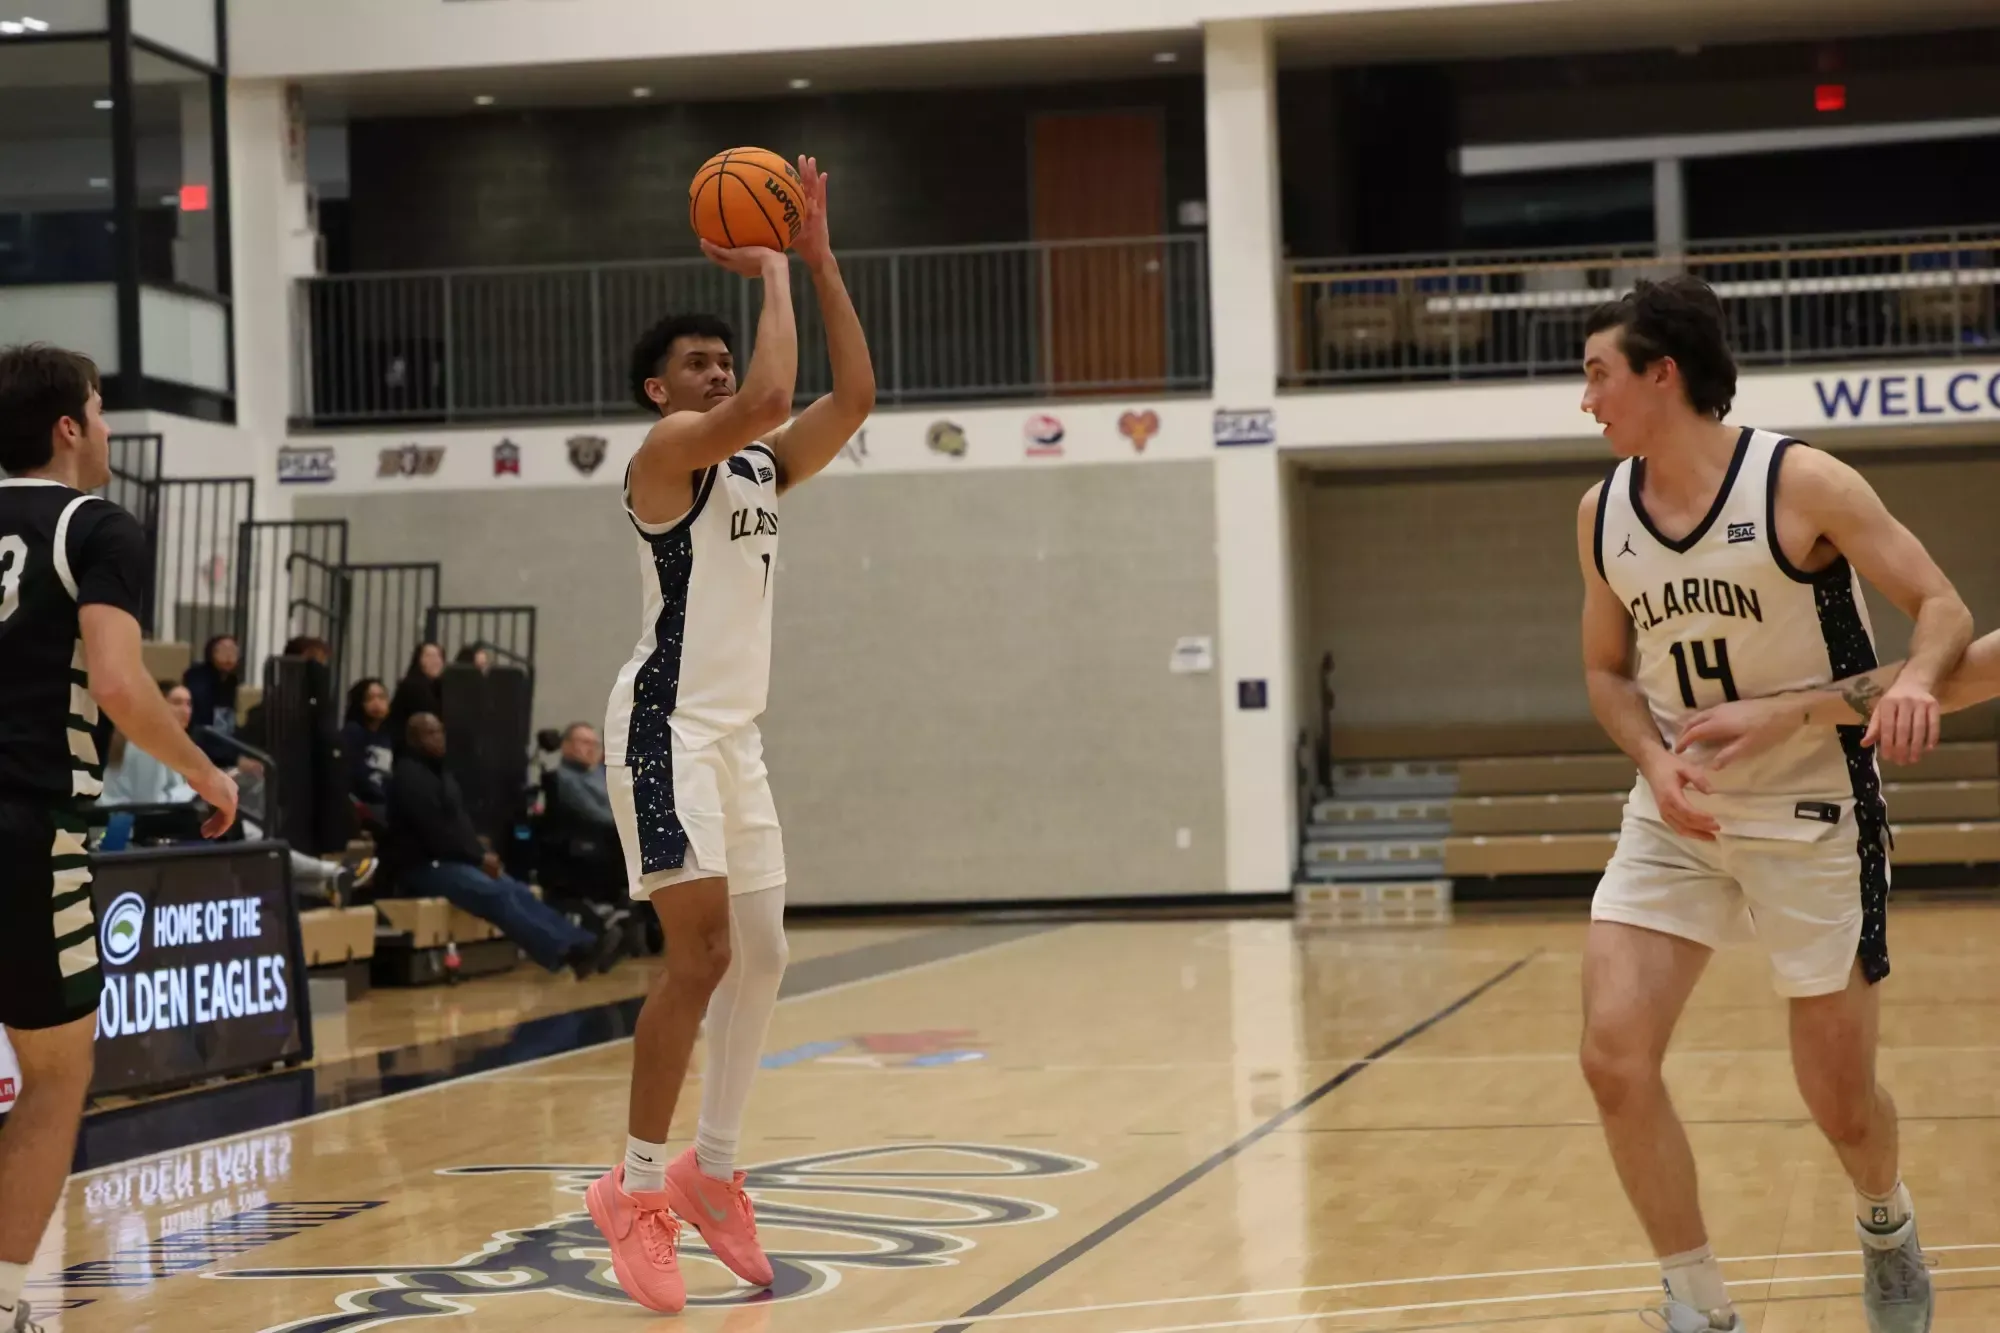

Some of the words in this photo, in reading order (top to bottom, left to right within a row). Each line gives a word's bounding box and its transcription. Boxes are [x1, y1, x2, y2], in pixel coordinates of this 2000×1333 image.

[1728, 526, 1756, 539] PSAC
[1631, 578, 1763, 631] CLARION
[1669, 638, 1741, 708] 14
[153, 902, 203, 948] HOME
[204, 900, 228, 942] OF
[229, 897, 262, 938] THE
[93, 966, 189, 1041] OLDEN
[194, 954, 288, 1024] EAGLES
